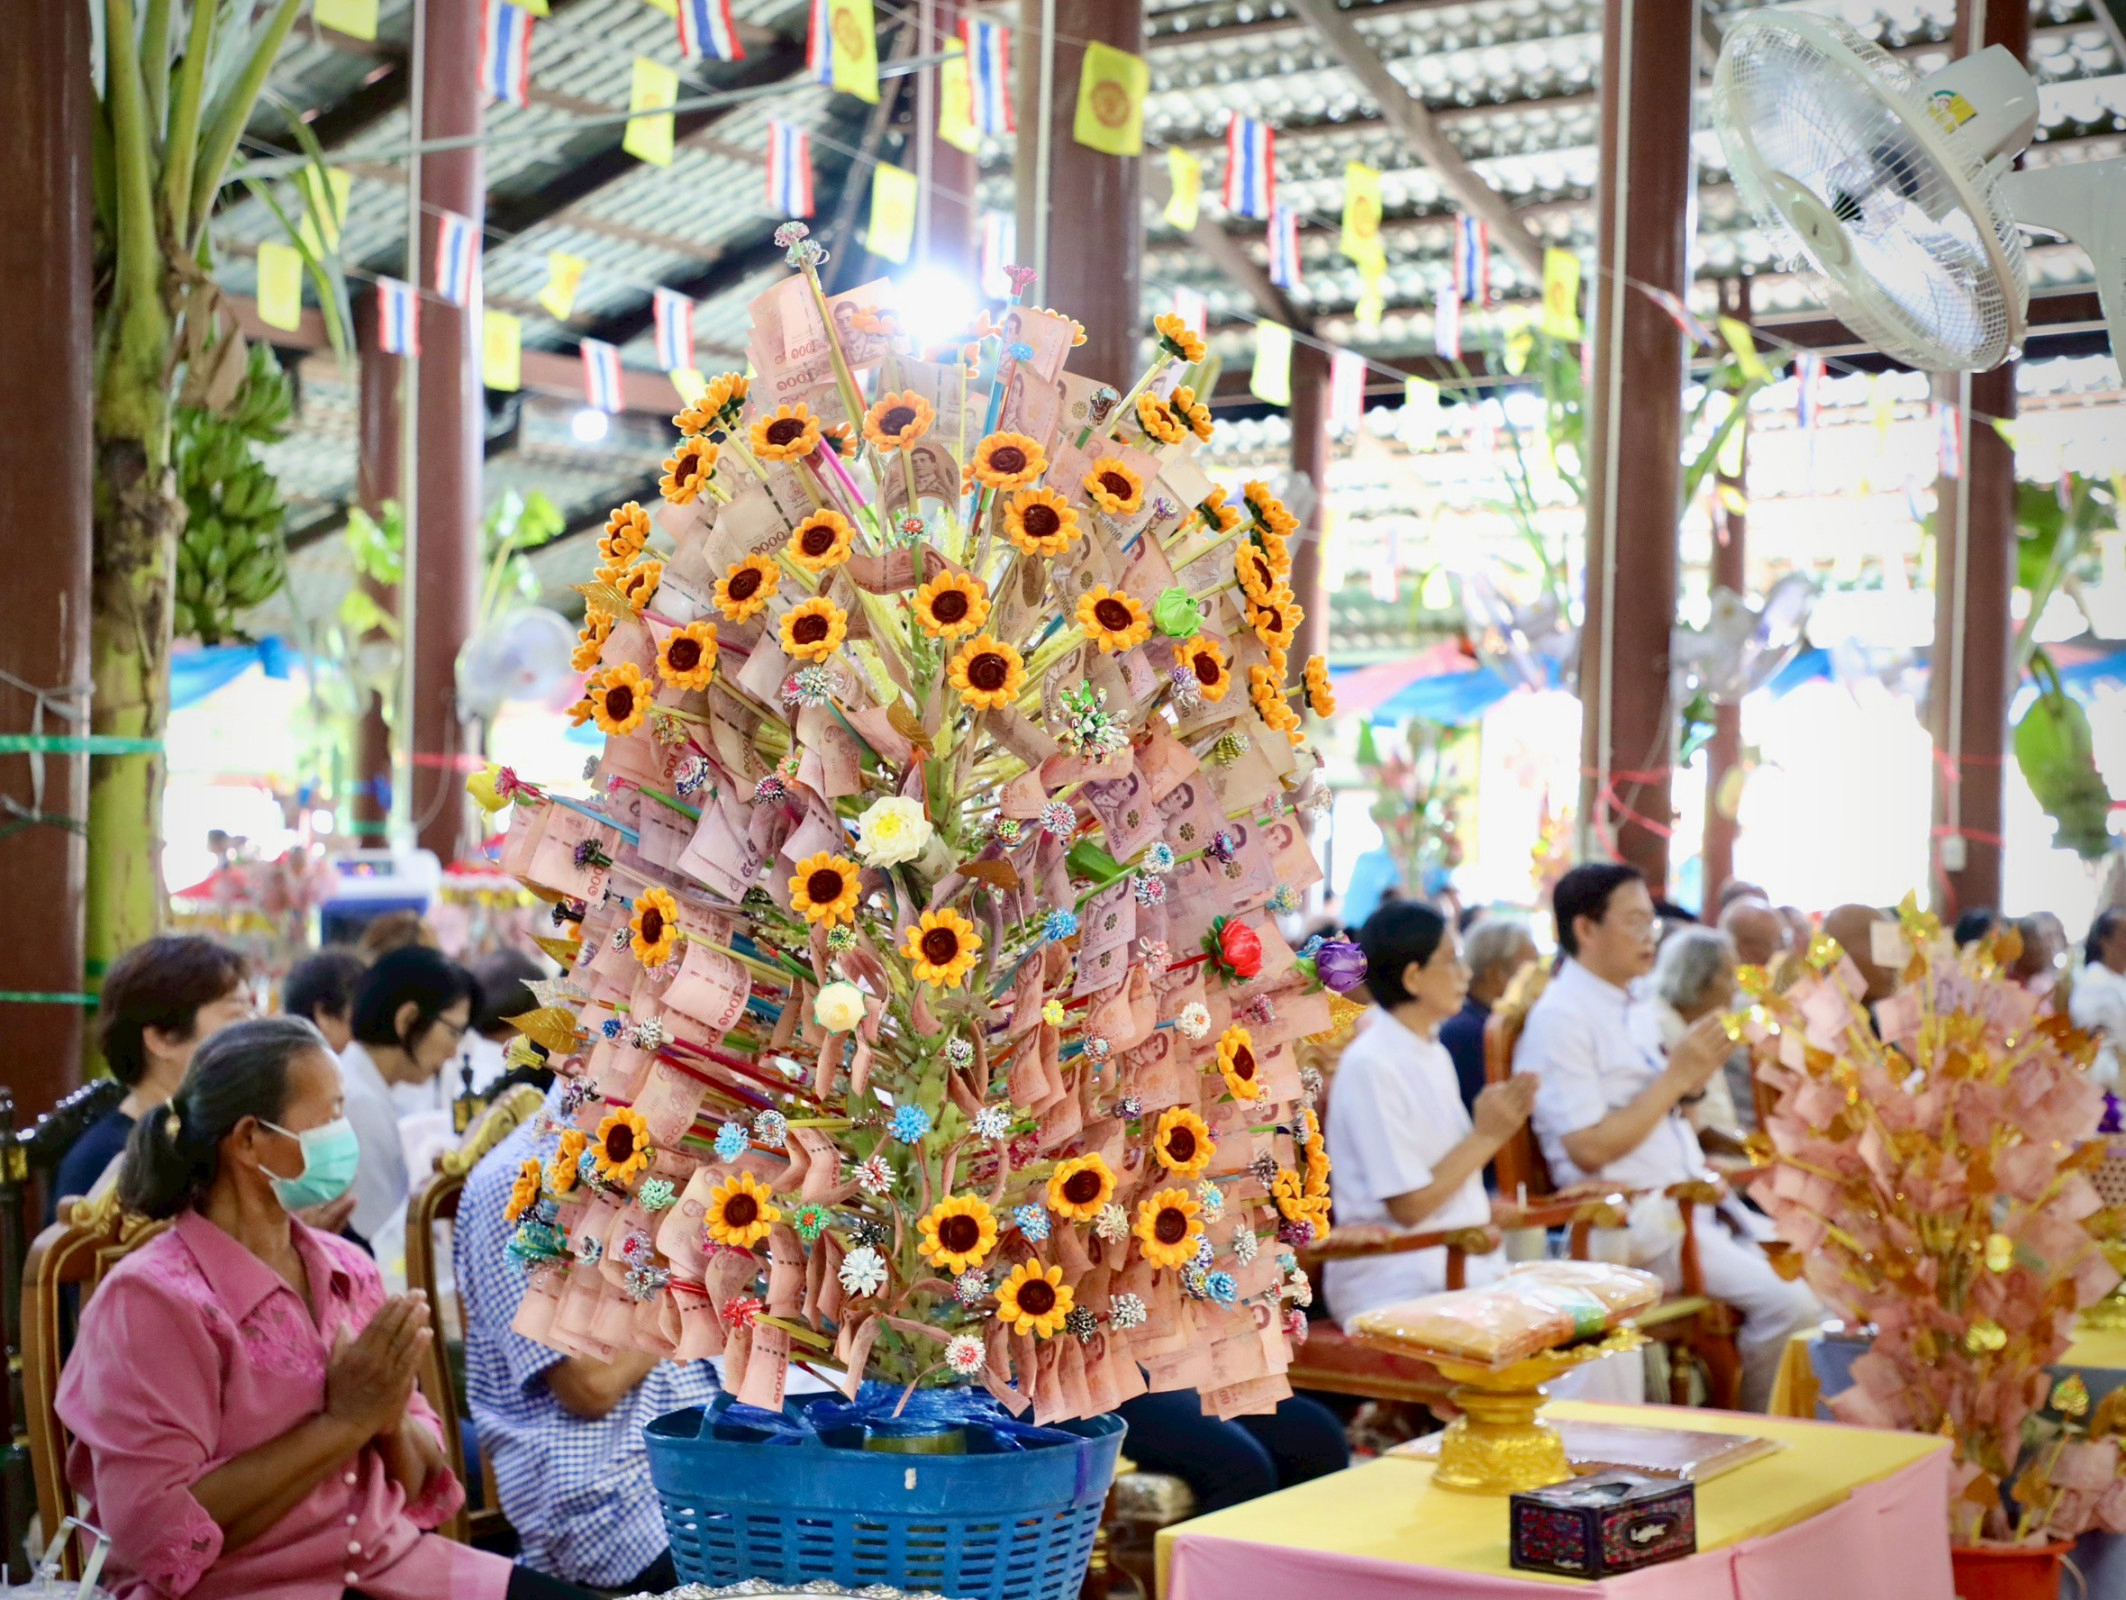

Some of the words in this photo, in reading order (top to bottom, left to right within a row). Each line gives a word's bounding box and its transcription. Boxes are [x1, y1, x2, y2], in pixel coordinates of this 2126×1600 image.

[664, 753, 677, 779] ๑๐
[1109, 828, 1122, 850] 500
[587, 866, 604, 897] ๑๐๐
[718, 998, 741, 1026] ๑๐๐
